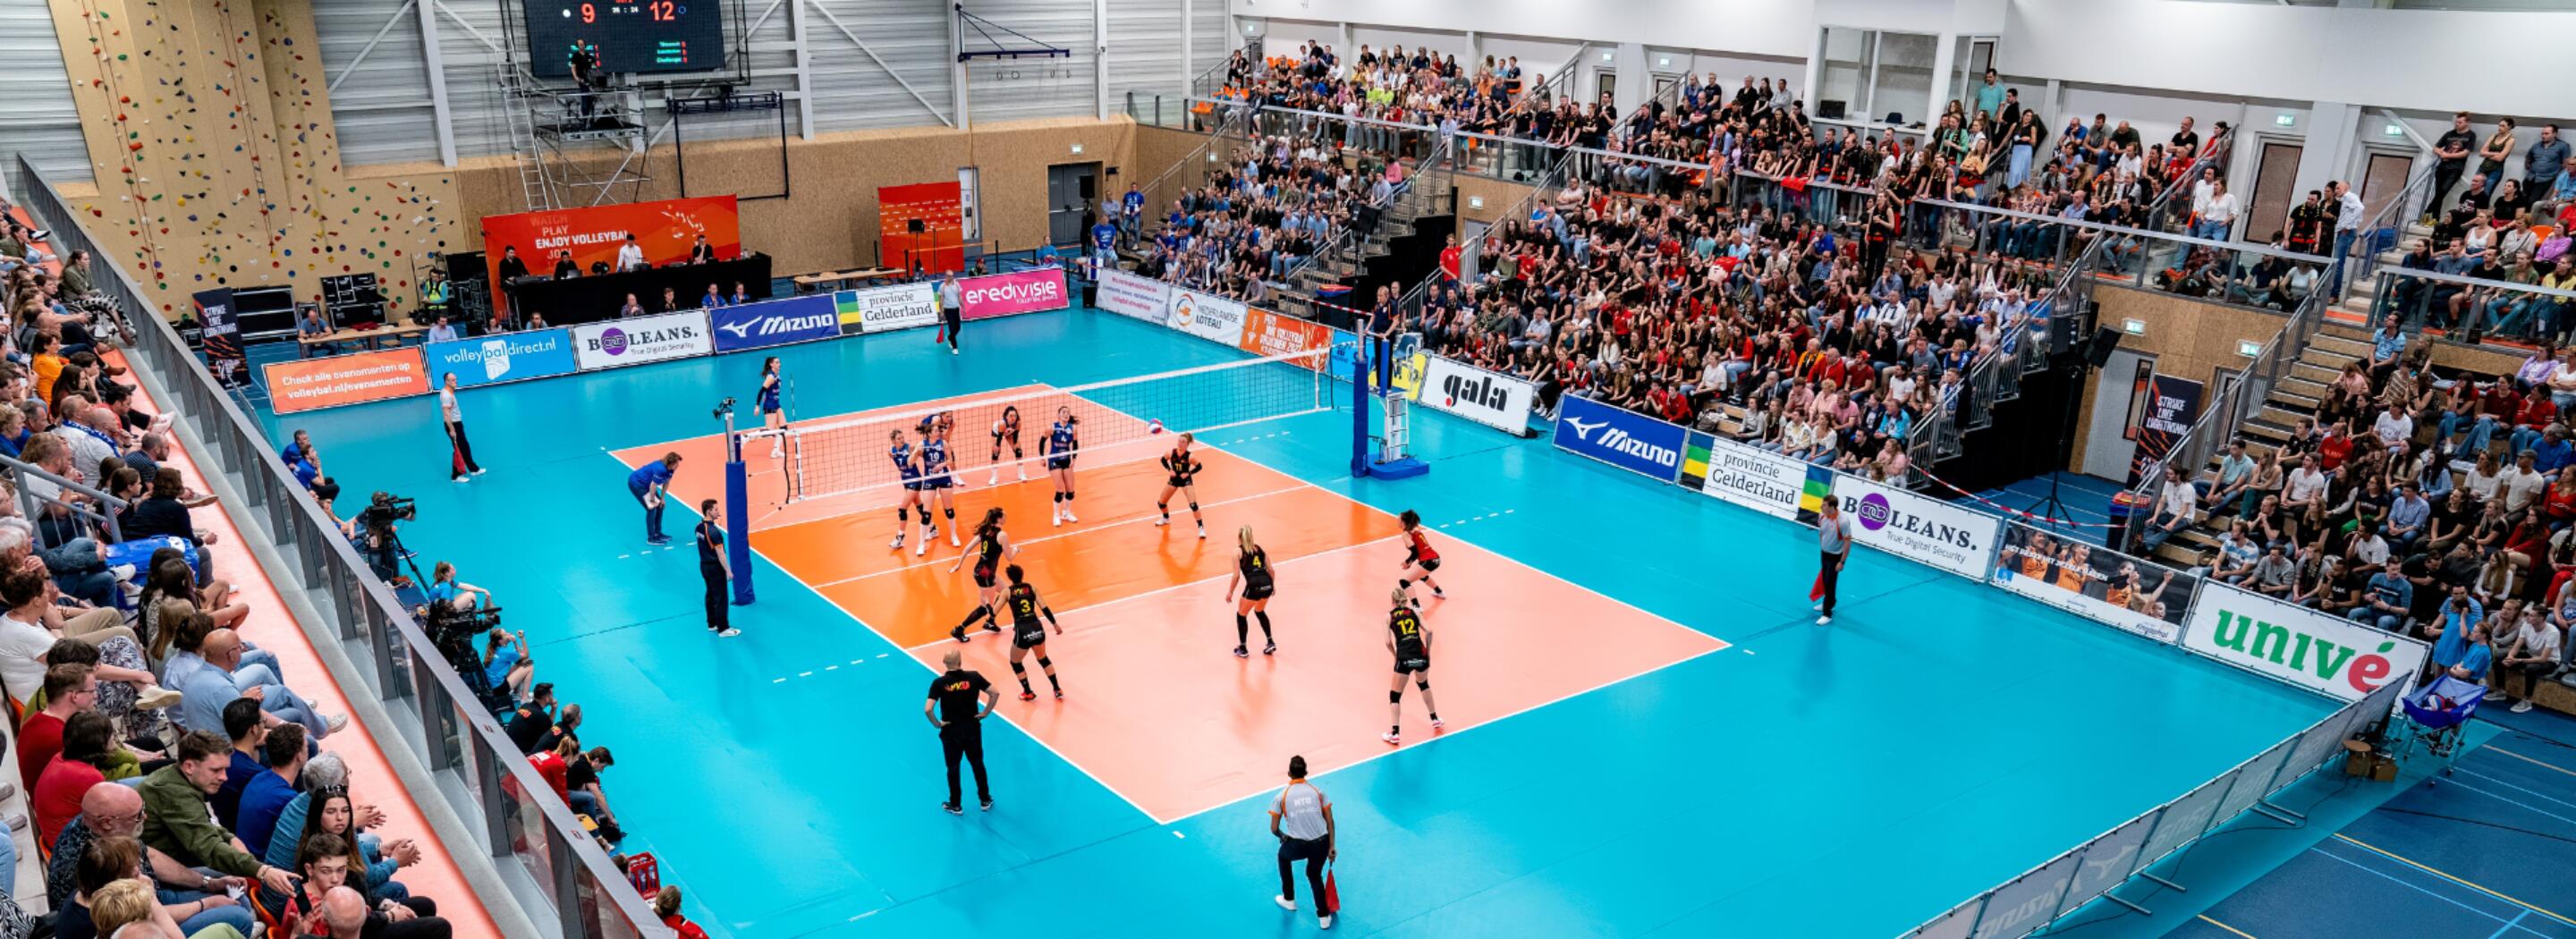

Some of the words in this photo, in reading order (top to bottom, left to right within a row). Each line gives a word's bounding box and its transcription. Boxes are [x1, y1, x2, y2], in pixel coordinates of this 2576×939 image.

[581, 4, 596, 23] 9
[649, 1, 675, 21] 12
[530, 214, 569, 228] WATCH
[542, 224, 569, 237] PLAY
[535, 236, 570, 250] ENJOY
[572, 230, 628, 245] VOLLEYBA
[869, 292, 914, 310] provincie
[965, 280, 1058, 305] eredivisie
[864, 304, 933, 323] Gelderland
[444, 336, 556, 365] volleybaldirect.nl
[282, 374, 313, 386] Check
[314, 372, 332, 381] alle
[333, 364, 394, 380] evenementen
[394, 362, 411, 372] op
[287, 375, 412, 399] volleybal.nl/evenementen
[1443, 376, 1508, 411] gala
[1724, 452, 1780, 478] provincie
[1712, 469, 1796, 505] Gelderland
[1886, 530, 1904, 543] True
[1906, 536, 1931, 554] Digital
[1933, 542, 1966, 564] Security
[1252, 554, 1262, 568] 4
[1020, 599, 1030, 613] 3
[1397, 617, 1418, 636] 12
[2212, 608, 2396, 694] univé
